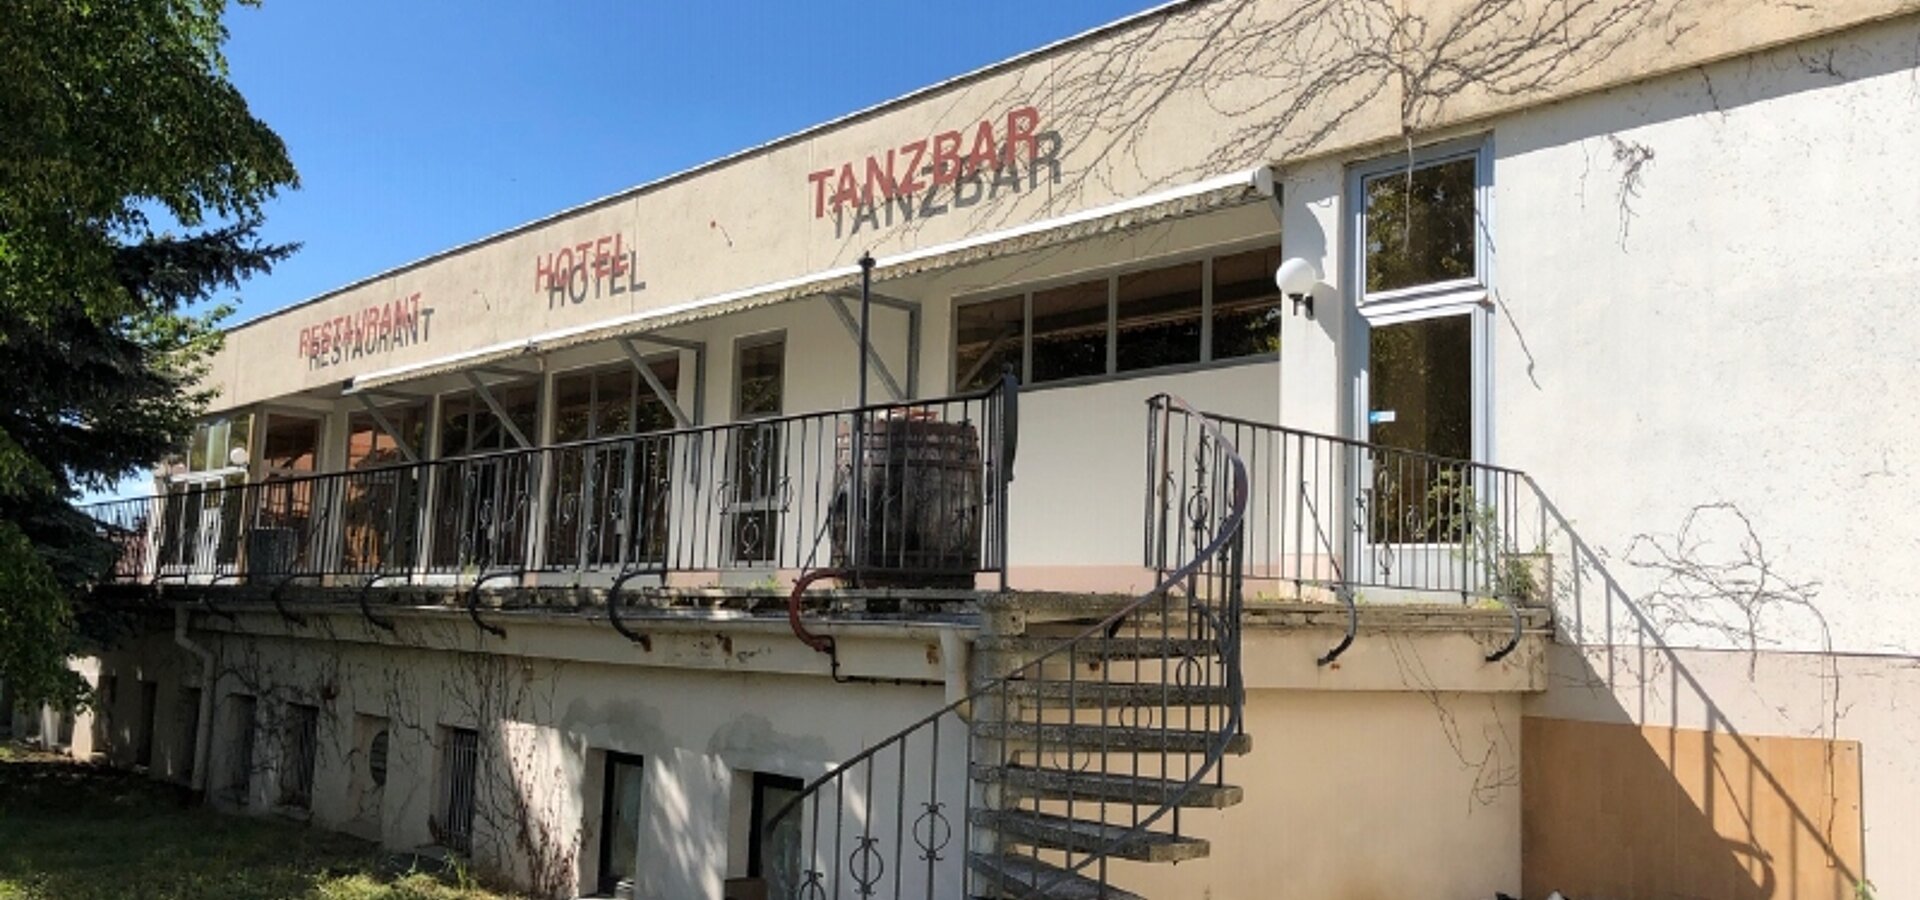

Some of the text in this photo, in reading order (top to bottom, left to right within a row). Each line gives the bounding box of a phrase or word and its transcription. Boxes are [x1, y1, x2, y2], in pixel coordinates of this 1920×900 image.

[808, 106, 1042, 219] TANZBAR
[535, 233, 629, 293] HOTEL
[299, 292, 421, 358] RESTAURANT
